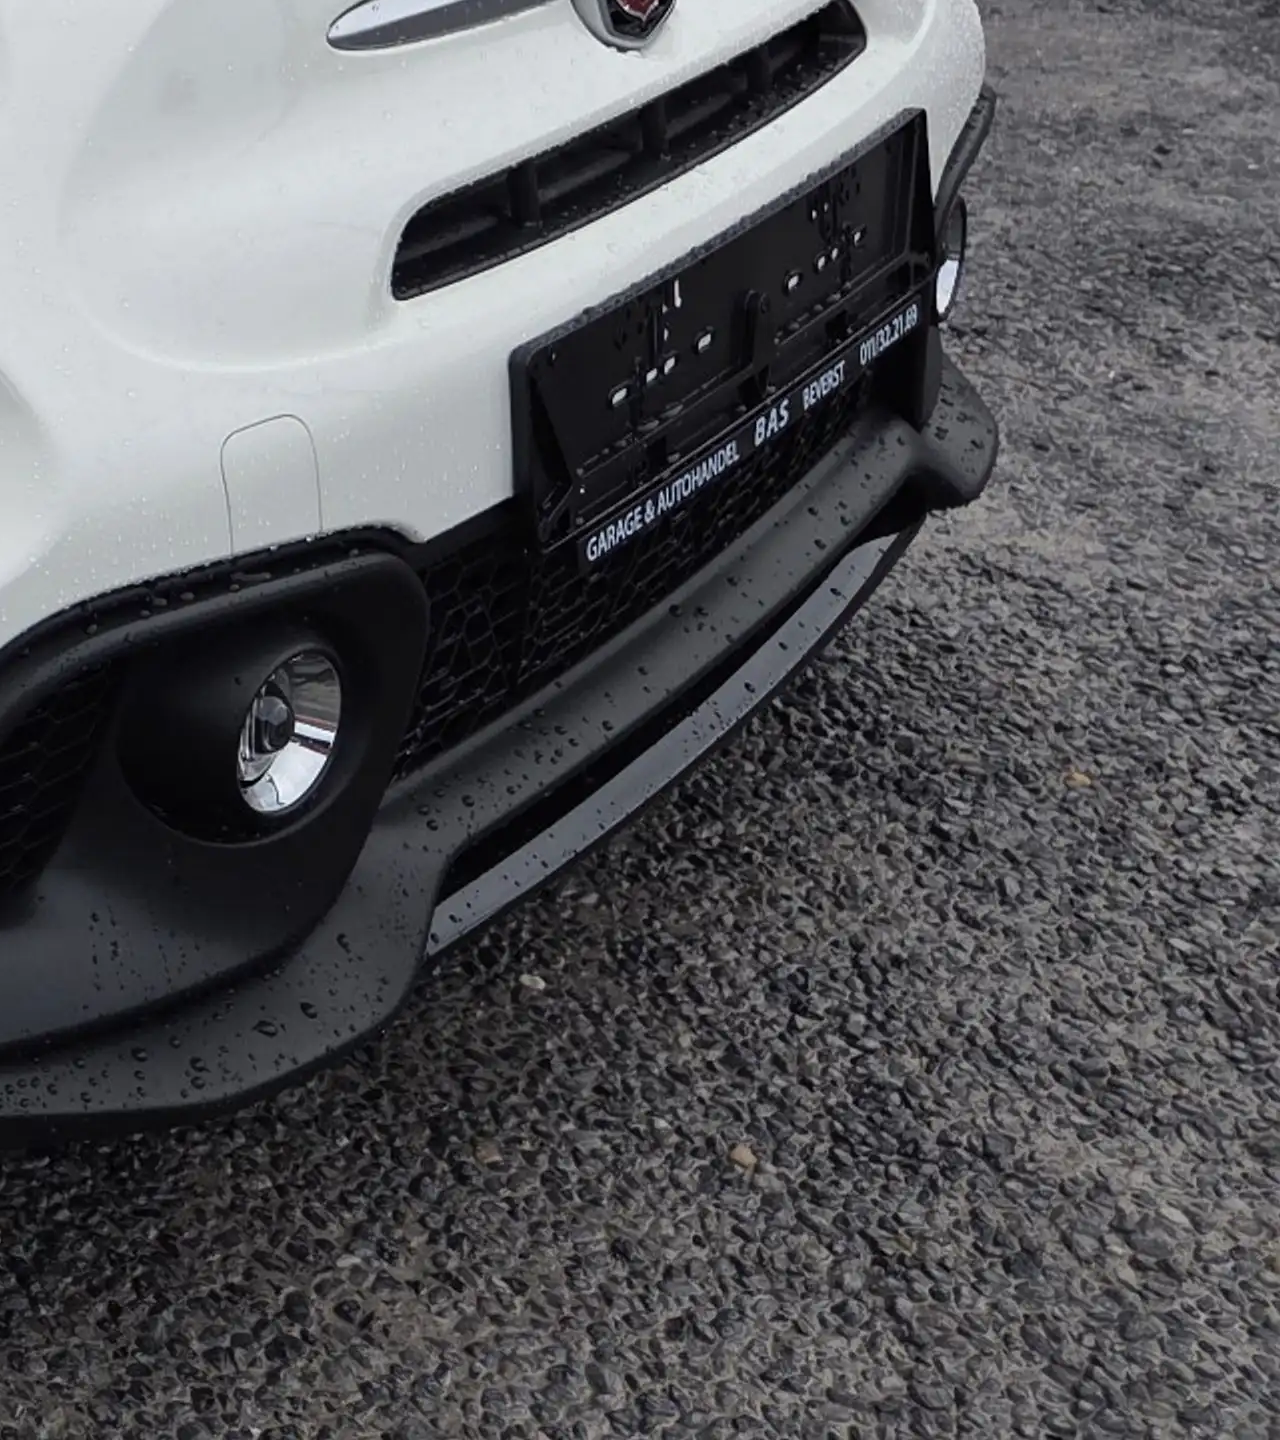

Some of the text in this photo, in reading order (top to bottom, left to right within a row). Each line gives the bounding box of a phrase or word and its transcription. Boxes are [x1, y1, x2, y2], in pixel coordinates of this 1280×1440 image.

[585, 505, 643, 562] GARAGE
[643, 499, 656, 524] &
[656, 439, 741, 516] AUTOHANDEL
[753, 397, 790, 448] BAS
[801, 359, 846, 411] BEVERST
